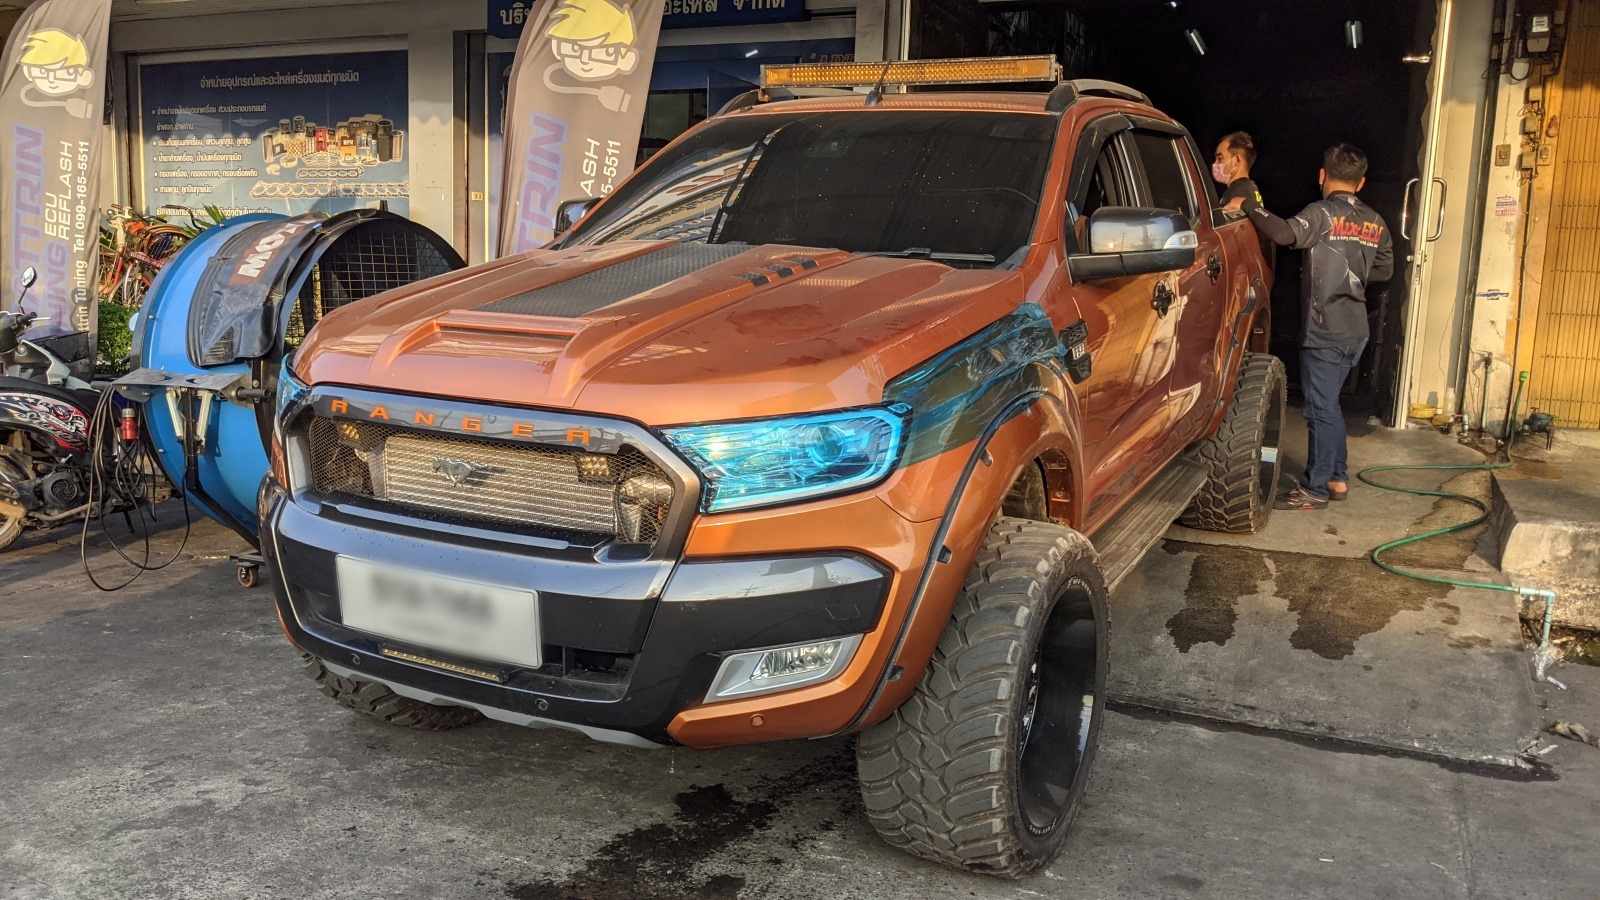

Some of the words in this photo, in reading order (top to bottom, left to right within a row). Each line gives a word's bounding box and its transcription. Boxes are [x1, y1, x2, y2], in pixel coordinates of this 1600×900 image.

[200, 70, 359, 90] จำหน่ายอุปกรณ์และอะไหล่เครื่องยนต์ทุกชนิด
[59, 141, 73, 240] REFLASH
[517, 114, 565, 253] TRIN
[600, 140, 621, 198] 5-5511
[45, 192, 57, 237] ECU
[46, 242, 67, 331] NING
[74, 260, 88, 303] Tuning
[77, 306, 90, 332] ttrin
[331, 399, 590, 444] RANGER
